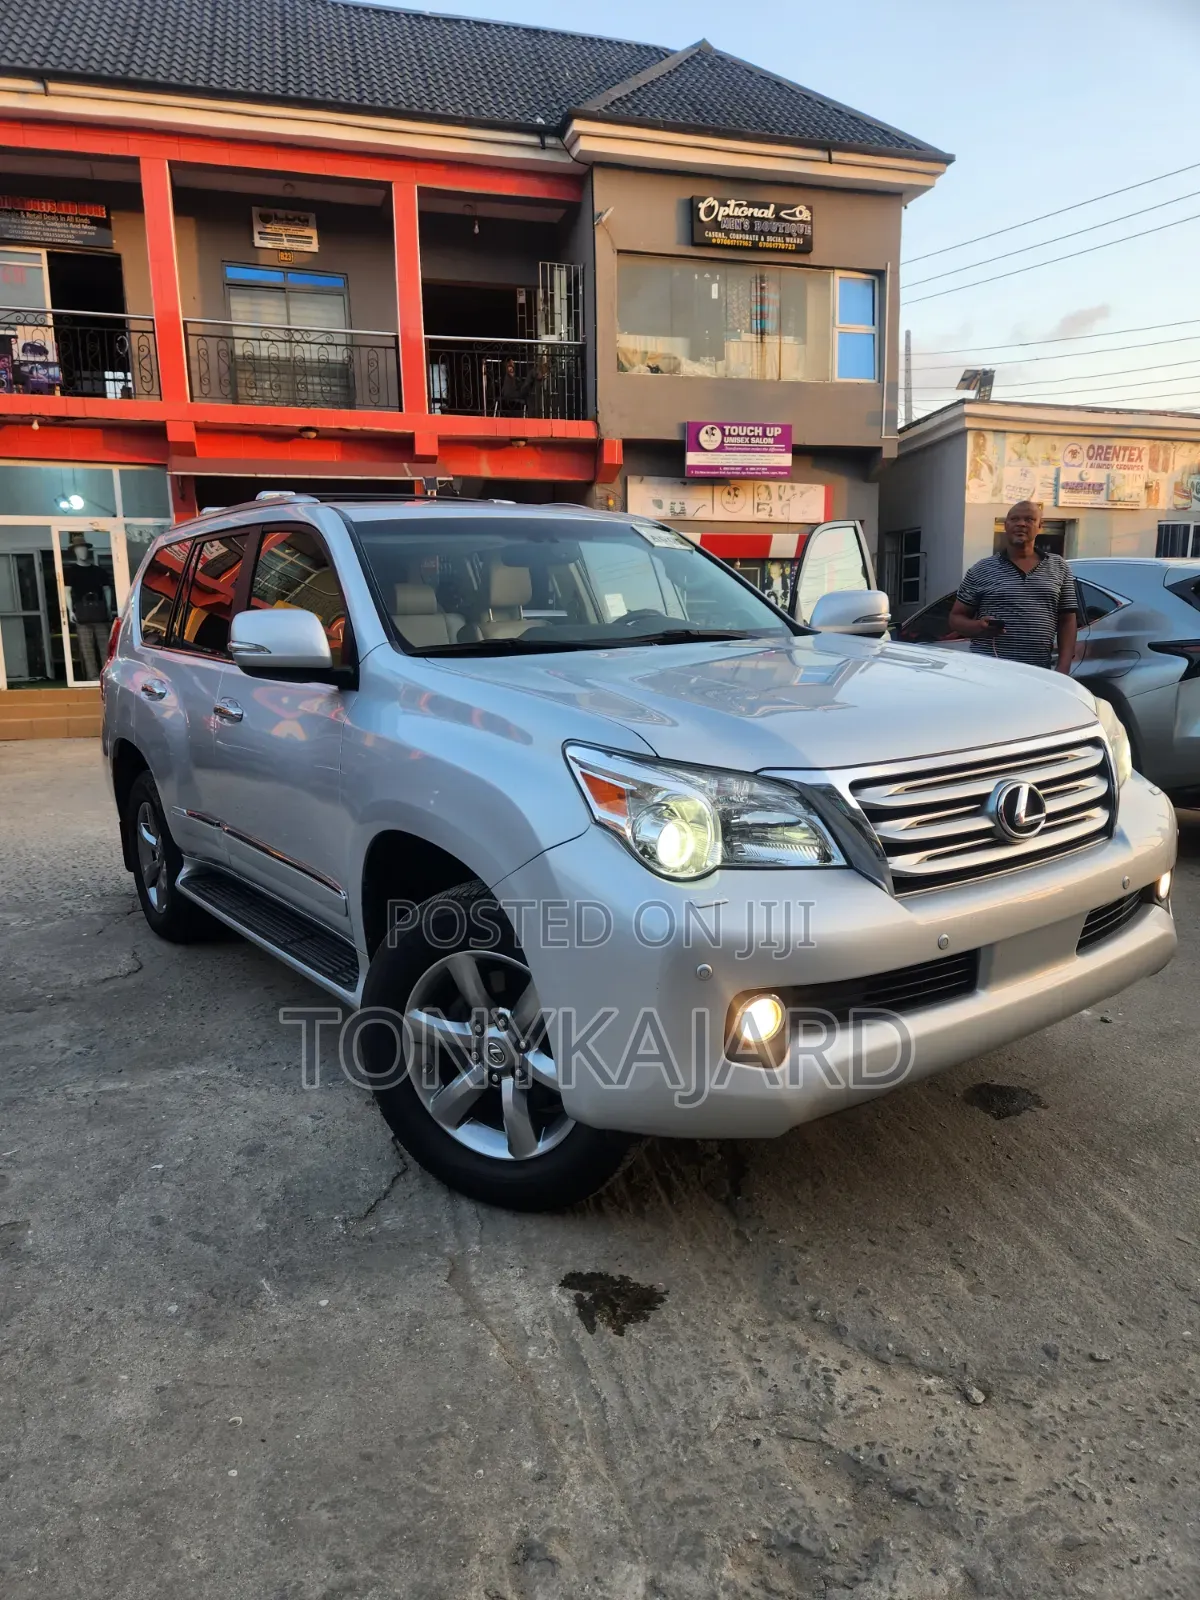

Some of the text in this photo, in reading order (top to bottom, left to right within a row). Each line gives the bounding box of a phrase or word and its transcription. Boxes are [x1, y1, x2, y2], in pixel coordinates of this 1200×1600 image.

[698, 196, 776, 222] Optional
[46, 220, 69, 228] Gadgets
[82, 223, 98, 231] More
[754, 220, 812, 236] BOUTIQUE
[729, 233, 758, 241] CORPORATE
[723, 425, 782, 437] TOUCH UP
[723, 436, 750, 444] UNISEX
[750, 437, 774, 445] SALON
[1086, 444, 1146, 462] ORENTEX
